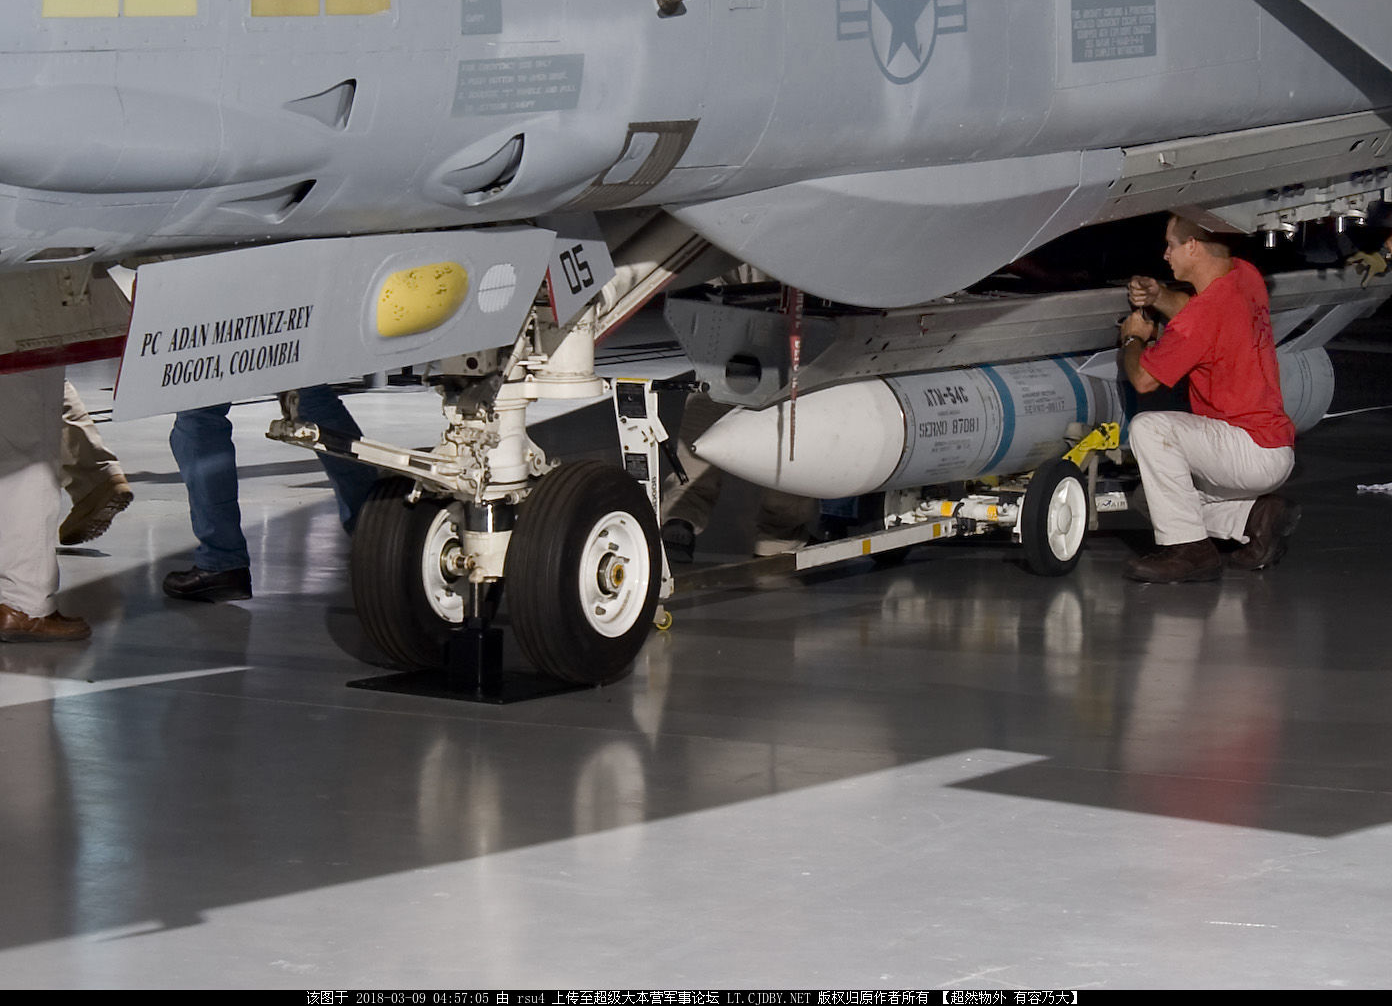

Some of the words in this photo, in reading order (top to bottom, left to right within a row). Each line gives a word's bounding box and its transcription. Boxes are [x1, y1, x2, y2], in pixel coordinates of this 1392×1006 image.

[559, 244, 595, 295] 05
[140, 331, 162, 356] PC
[168, 322, 210, 352] ADAN
[212, 305, 314, 345] MARTINEZ-REY
[161, 354, 224, 387] BOGOTA,
[230, 340, 300, 375] COLOMBIA
